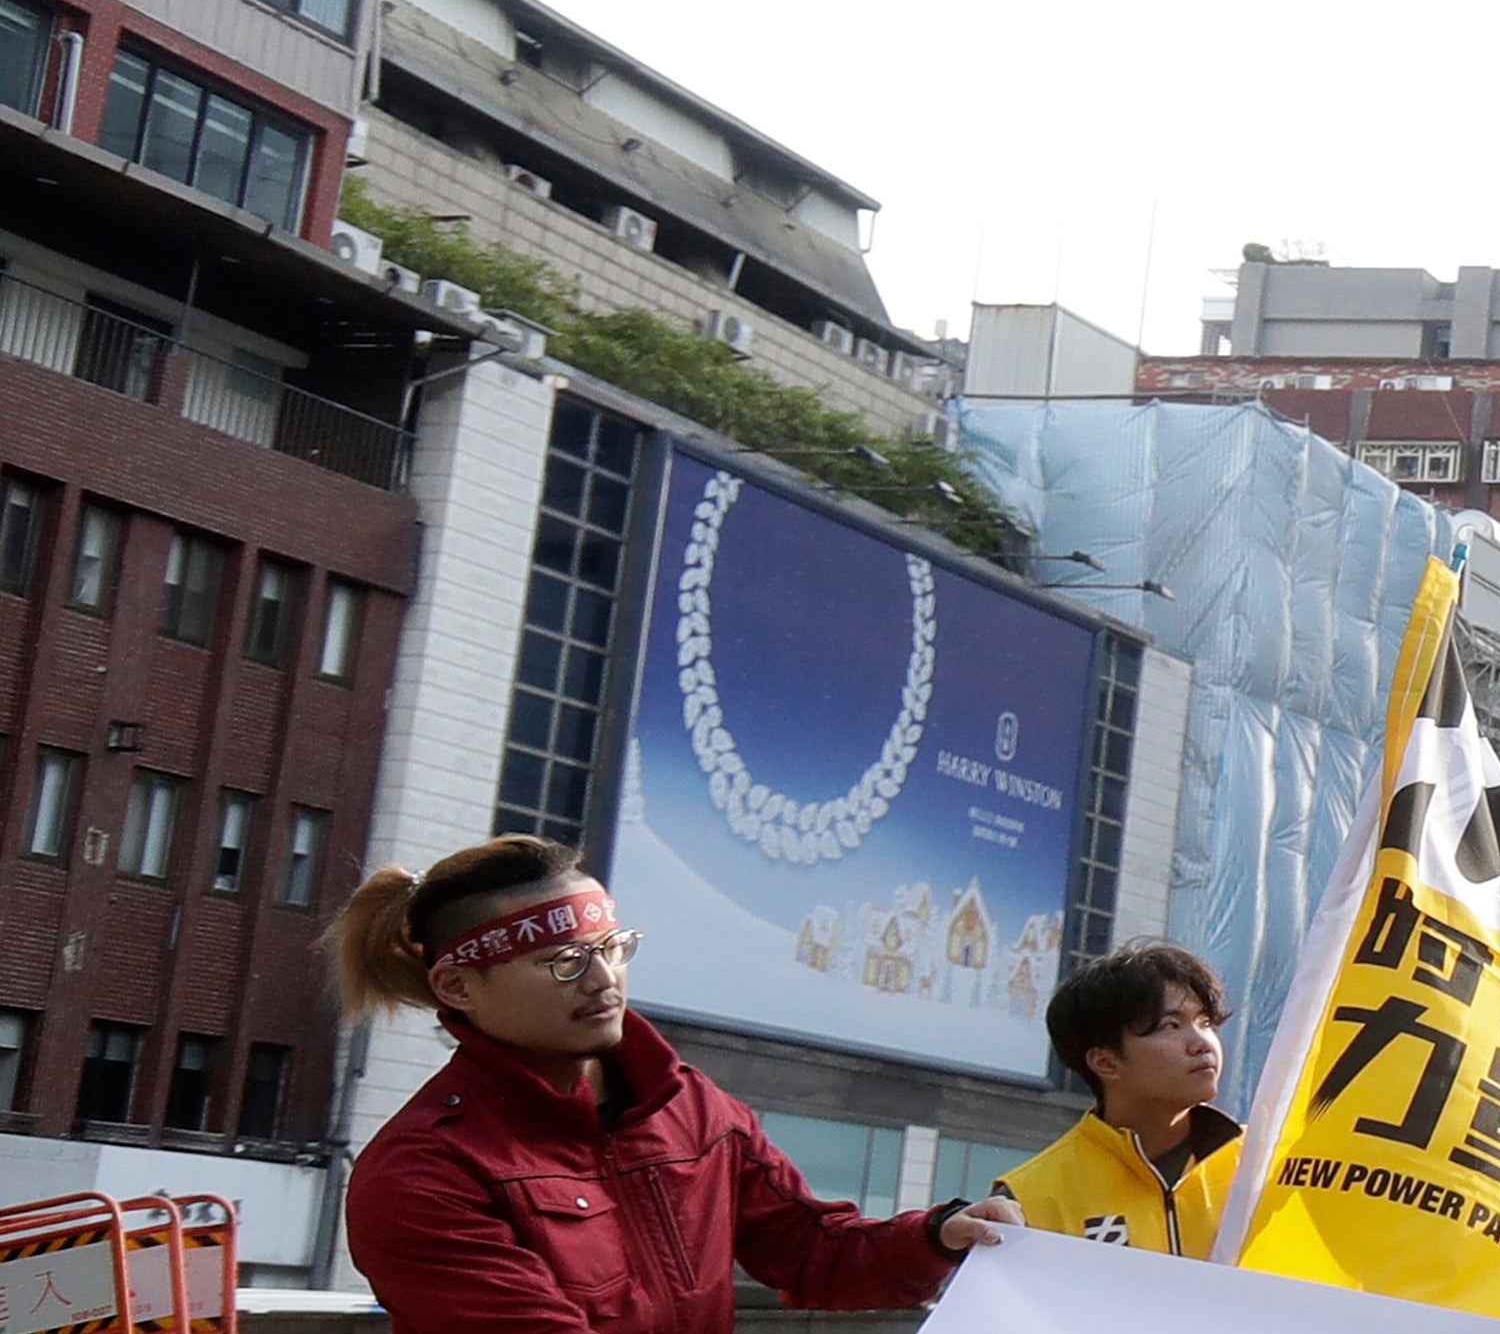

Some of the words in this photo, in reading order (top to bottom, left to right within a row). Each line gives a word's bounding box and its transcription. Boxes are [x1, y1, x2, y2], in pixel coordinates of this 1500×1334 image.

[993, 769, 1064, 810] WINSTON
[1277, 1156, 1343, 1190] NEW
[1340, 1163, 1466, 1222] POWER
